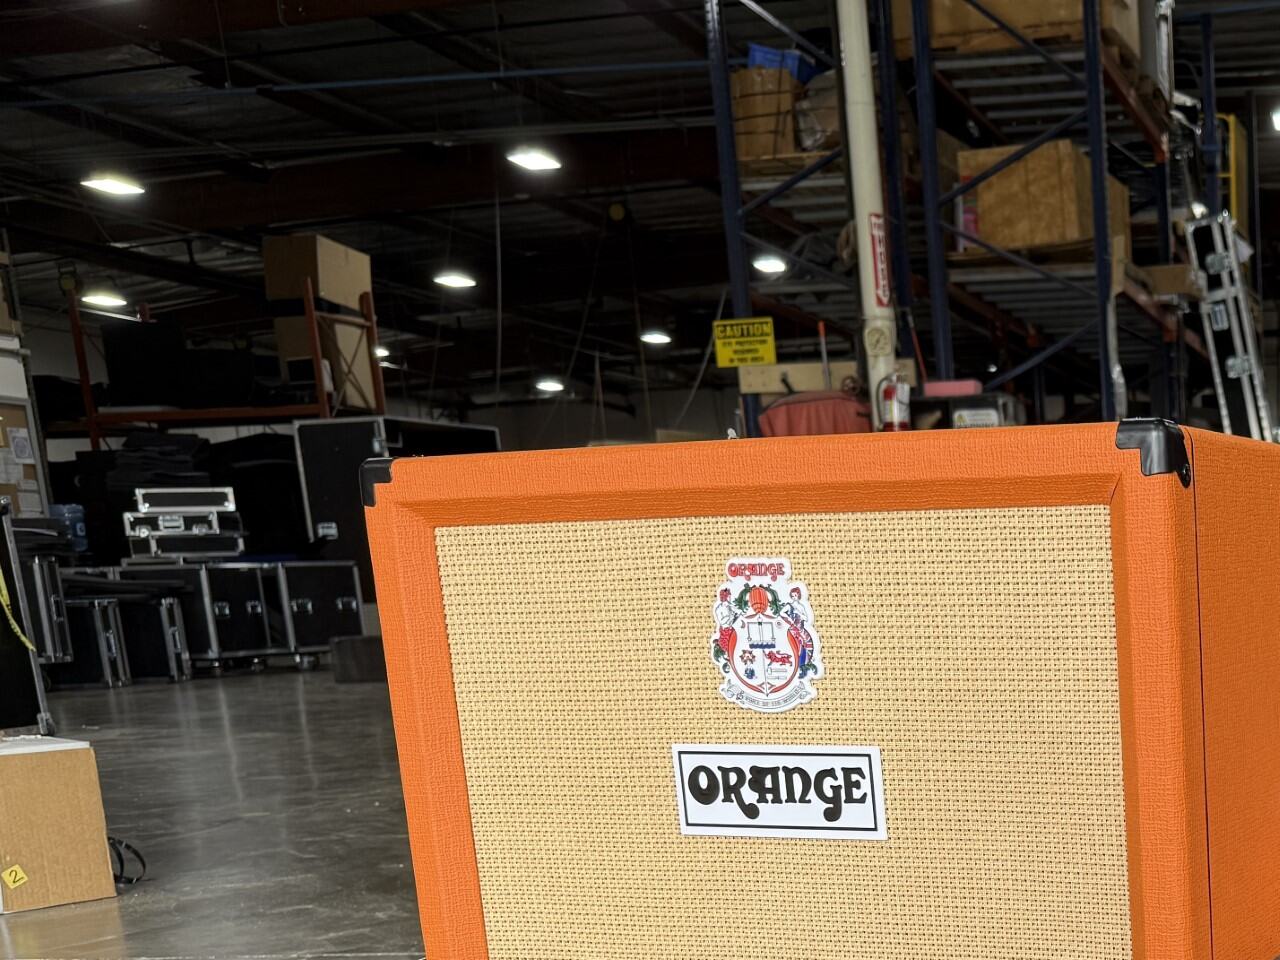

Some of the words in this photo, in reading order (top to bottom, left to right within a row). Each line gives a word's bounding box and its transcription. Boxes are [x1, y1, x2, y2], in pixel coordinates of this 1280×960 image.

[717, 323, 770, 338] CAUTION
[728, 563, 785, 582] ORANGE
[687, 765, 868, 823] ORANGE
[9, 869, 24, 884] 2
